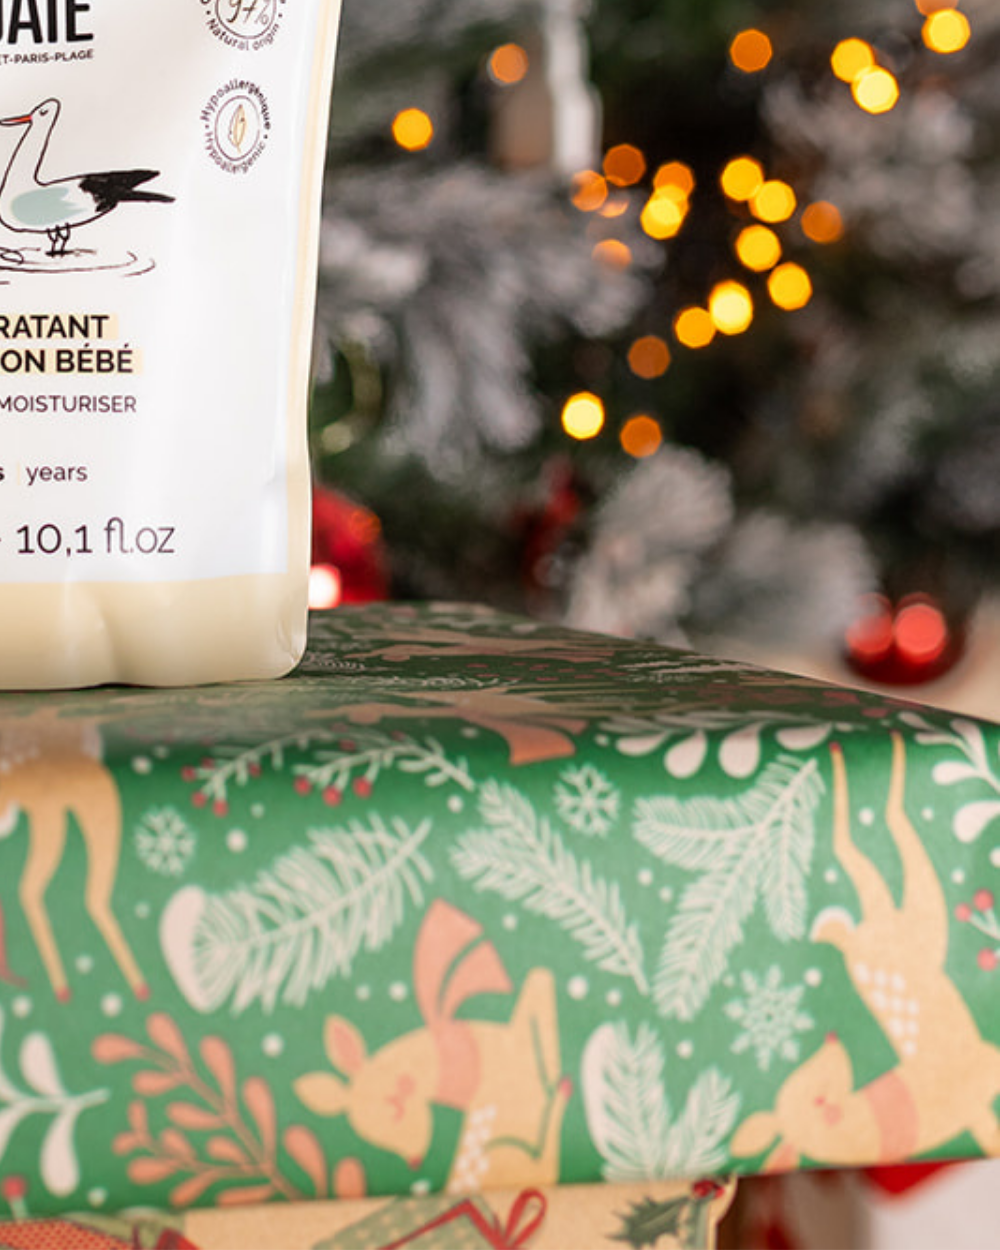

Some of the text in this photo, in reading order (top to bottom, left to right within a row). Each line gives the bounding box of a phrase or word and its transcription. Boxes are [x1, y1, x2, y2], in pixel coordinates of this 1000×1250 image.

[206, 18, 279, 51] Natural origin
[56, 342, 133, 373] BÉBÉ
[26, 465, 88, 486] years
[16, 524, 93, 557] 10,1
